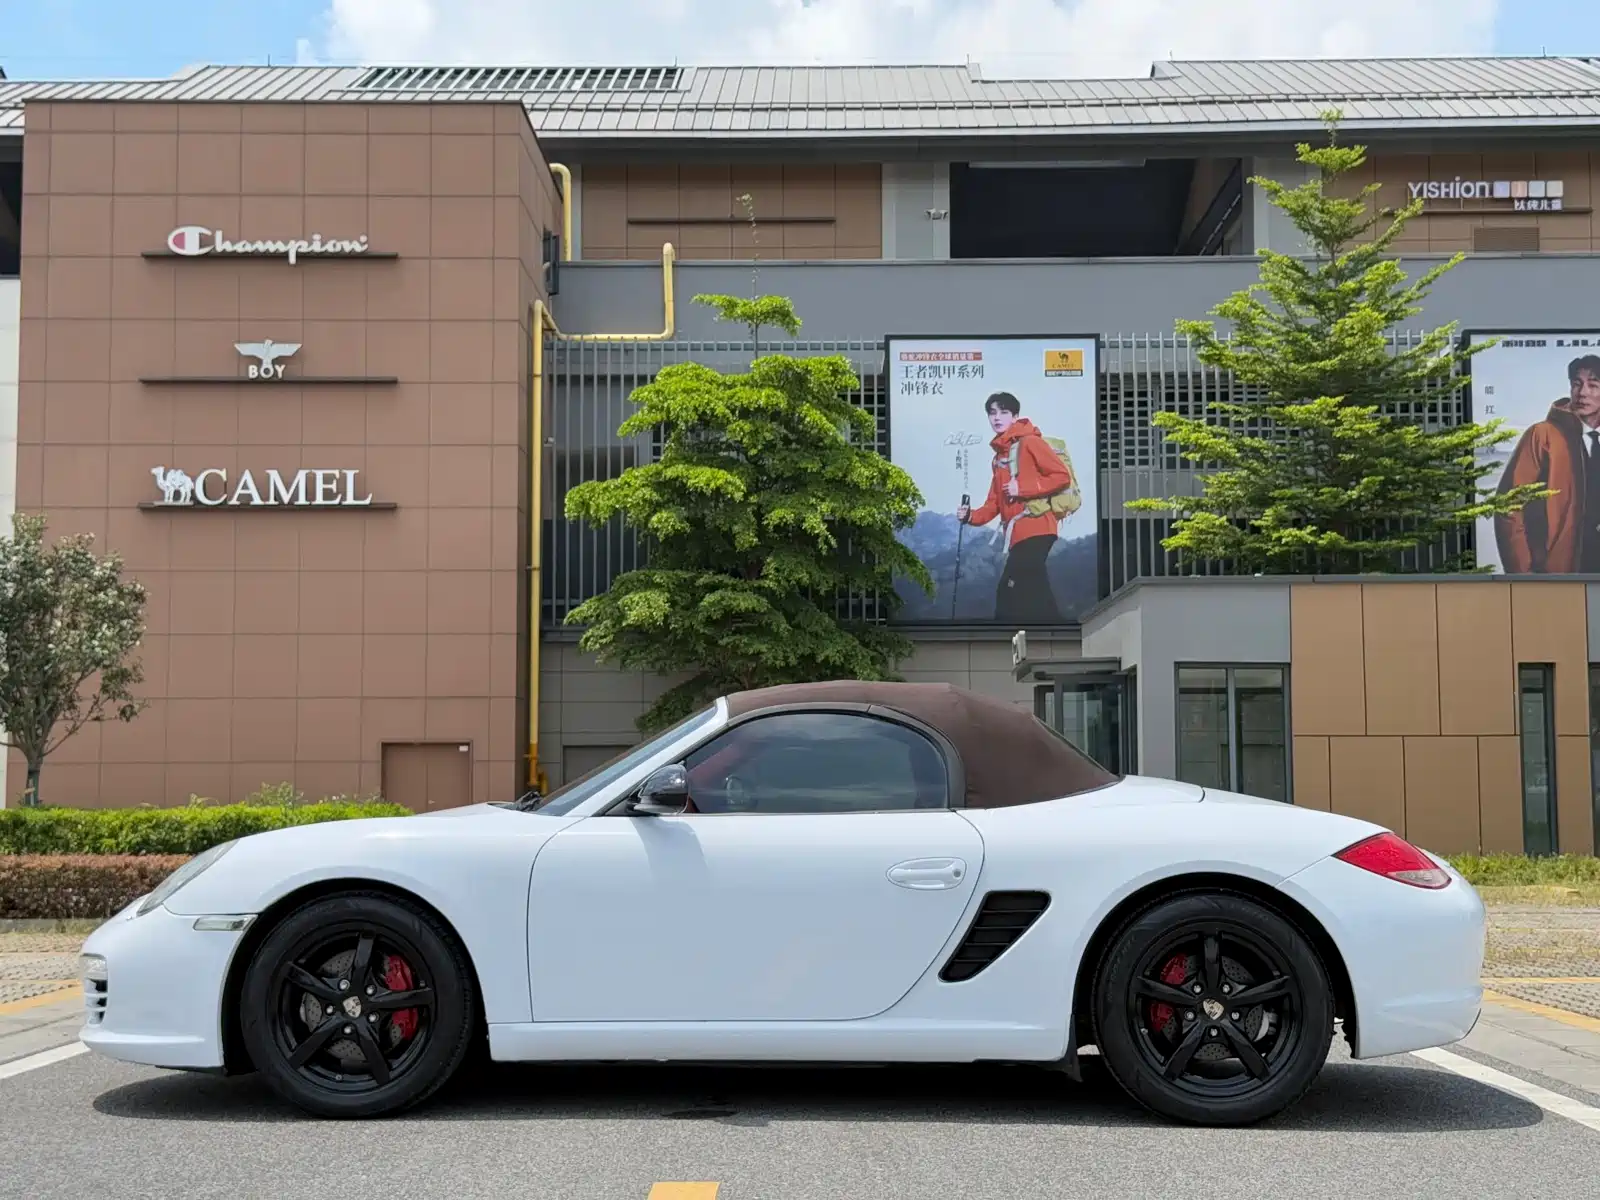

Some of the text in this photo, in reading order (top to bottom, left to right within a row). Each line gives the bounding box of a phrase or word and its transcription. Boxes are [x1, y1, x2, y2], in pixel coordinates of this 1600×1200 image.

[167, 225, 366, 264] Champion
[248, 364, 286, 379] BOY
[901, 364, 984, 379] 王者凯甲系列
[901, 381, 944, 396] 冲锋衣
[195, 468, 373, 506] CAMEL
